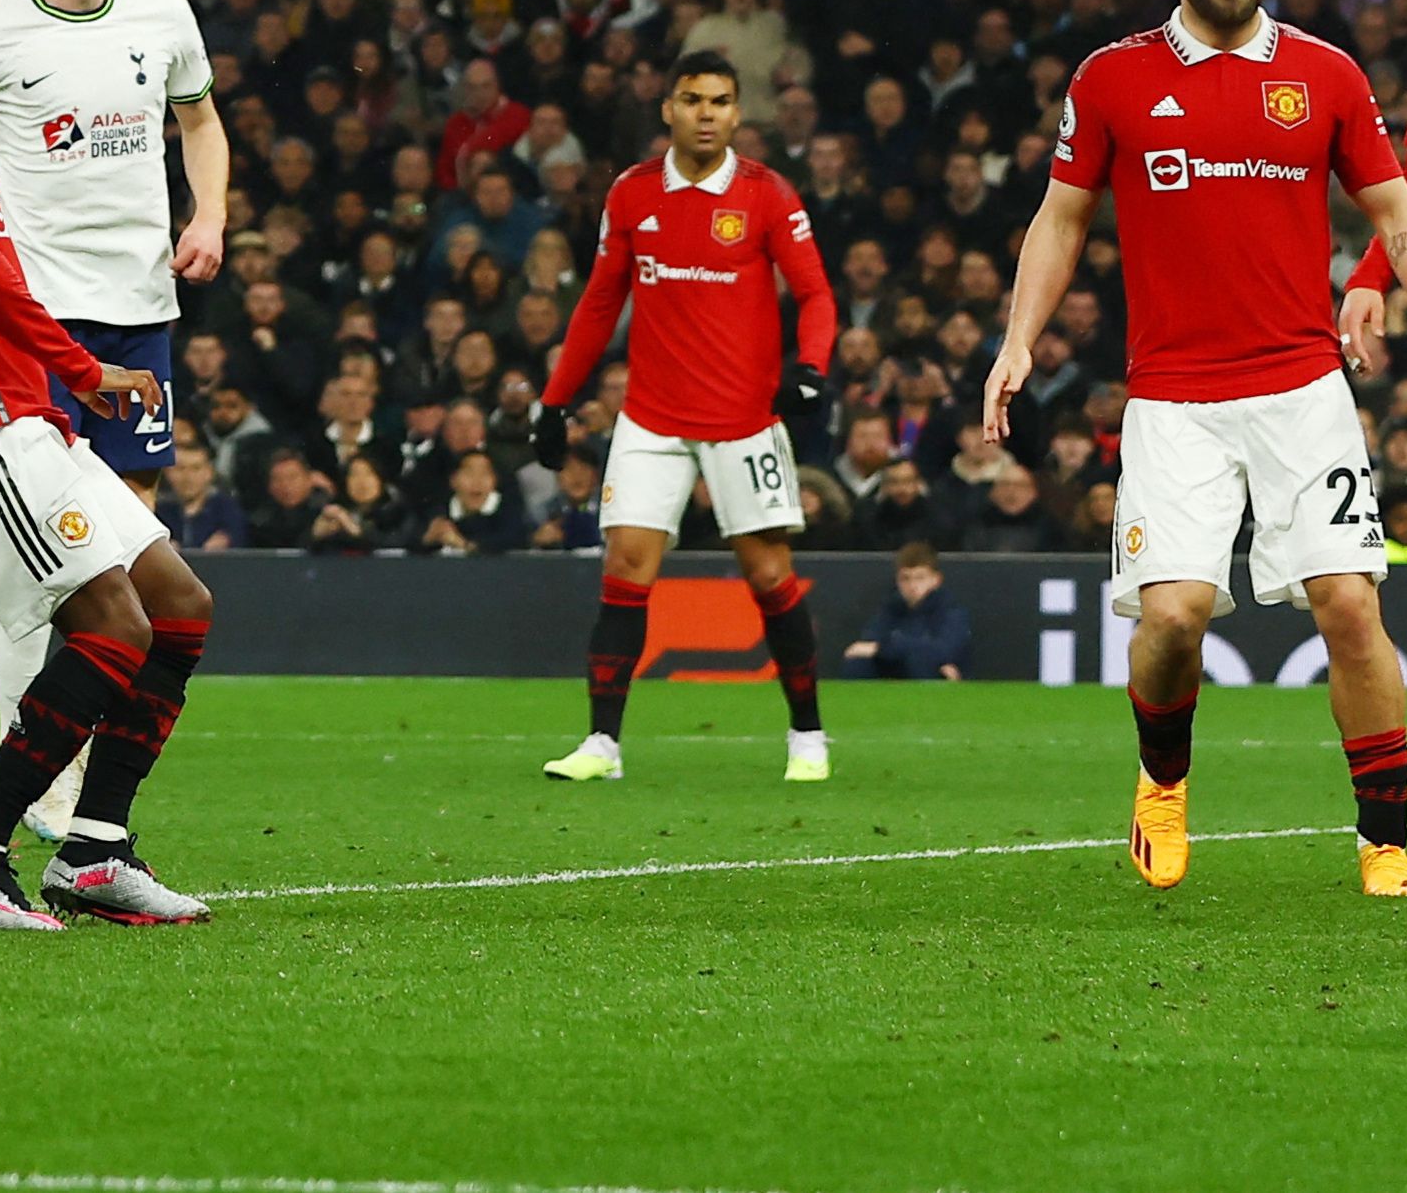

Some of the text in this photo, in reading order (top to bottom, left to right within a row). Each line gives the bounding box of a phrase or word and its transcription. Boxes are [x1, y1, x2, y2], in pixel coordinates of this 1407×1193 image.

[91, 113, 123, 128] AIA
[91, 124, 146, 140] READING FOR
[91, 136, 147, 158] DREAMS
[1189, 158, 1309, 182] TeamViewer
[655, 262, 737, 285] TeamViewer
[743, 452, 781, 493] 18
